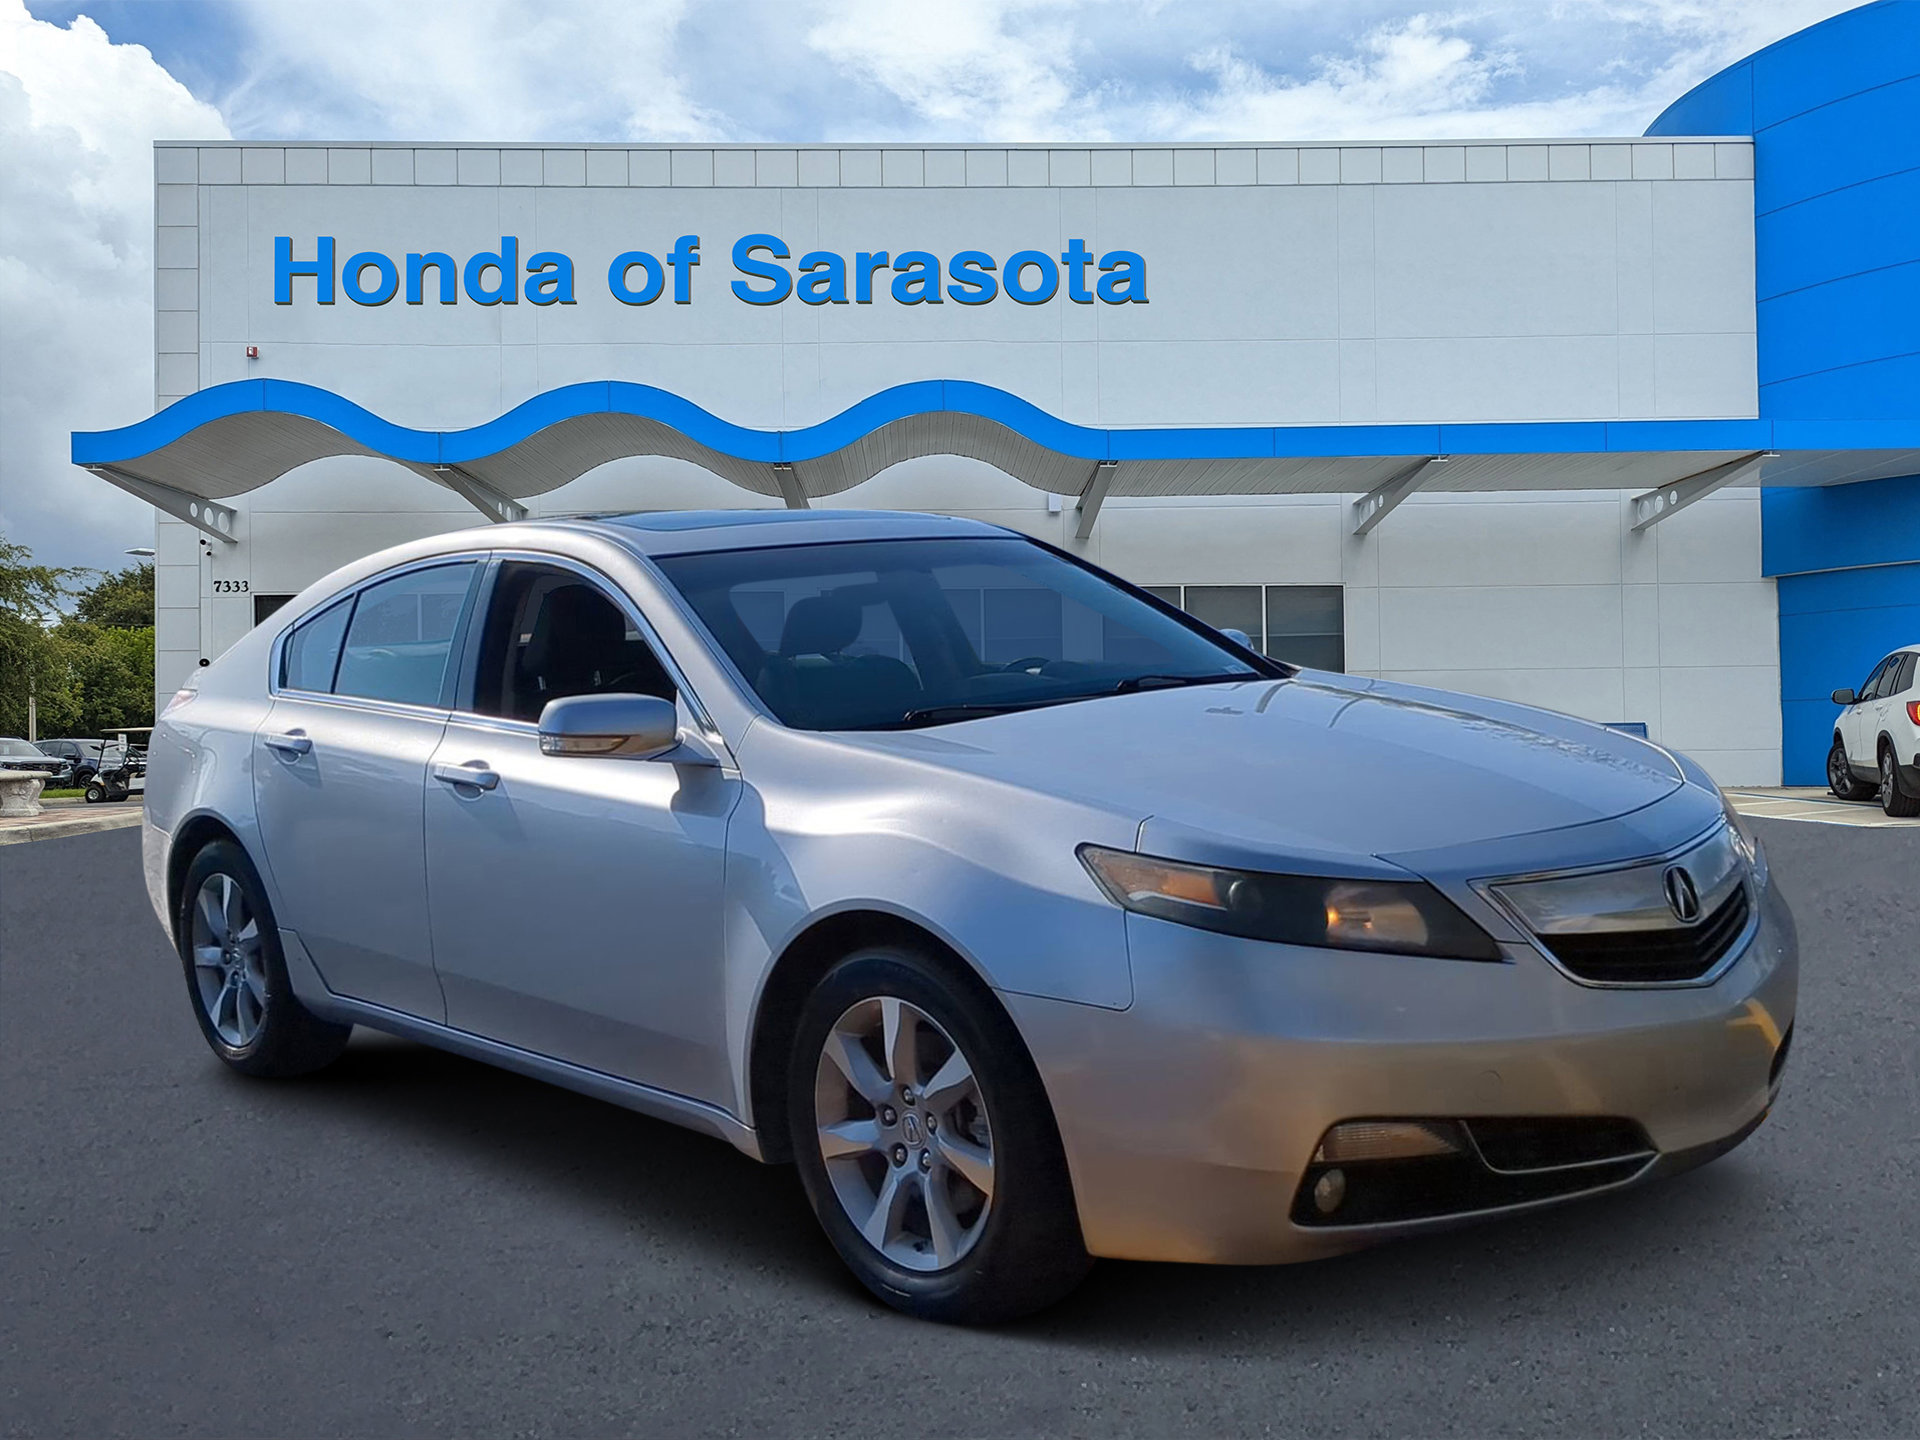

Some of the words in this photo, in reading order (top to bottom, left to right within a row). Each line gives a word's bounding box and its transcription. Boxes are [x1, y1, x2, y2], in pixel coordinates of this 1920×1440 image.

[273, 235, 577, 306] Honda
[607, 234, 701, 306] of
[730, 233, 1150, 306] Sarasota
[213, 580, 249, 593] 7333
